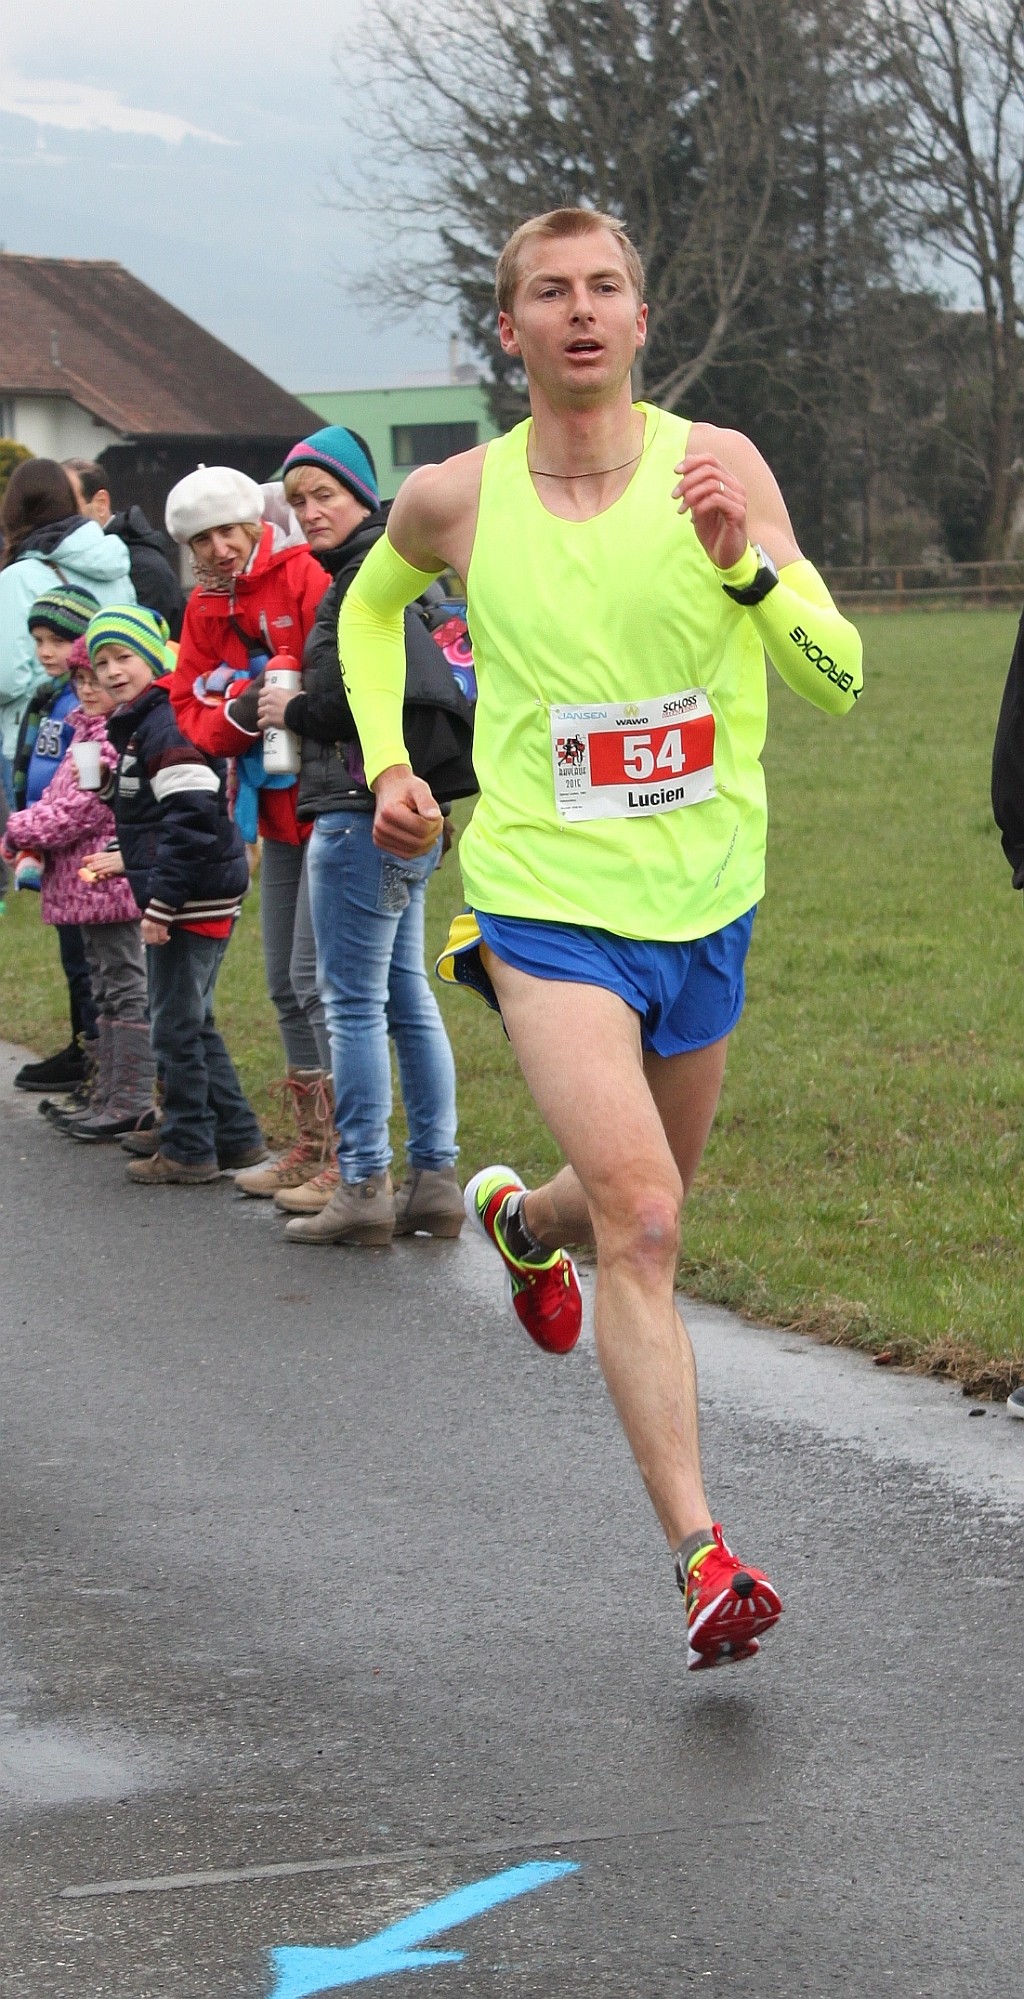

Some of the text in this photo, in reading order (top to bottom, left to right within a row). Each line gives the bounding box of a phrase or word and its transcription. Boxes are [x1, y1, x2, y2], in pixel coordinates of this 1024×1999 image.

[789, 625, 854, 693] BROOKS
[662, 694, 697, 713] SCHLOSS
[557, 710, 608, 720] JANSEN
[615, 717, 649, 726] WAWO
[623, 728, 686, 780] 54
[627, 786, 685, 808] Lucien
